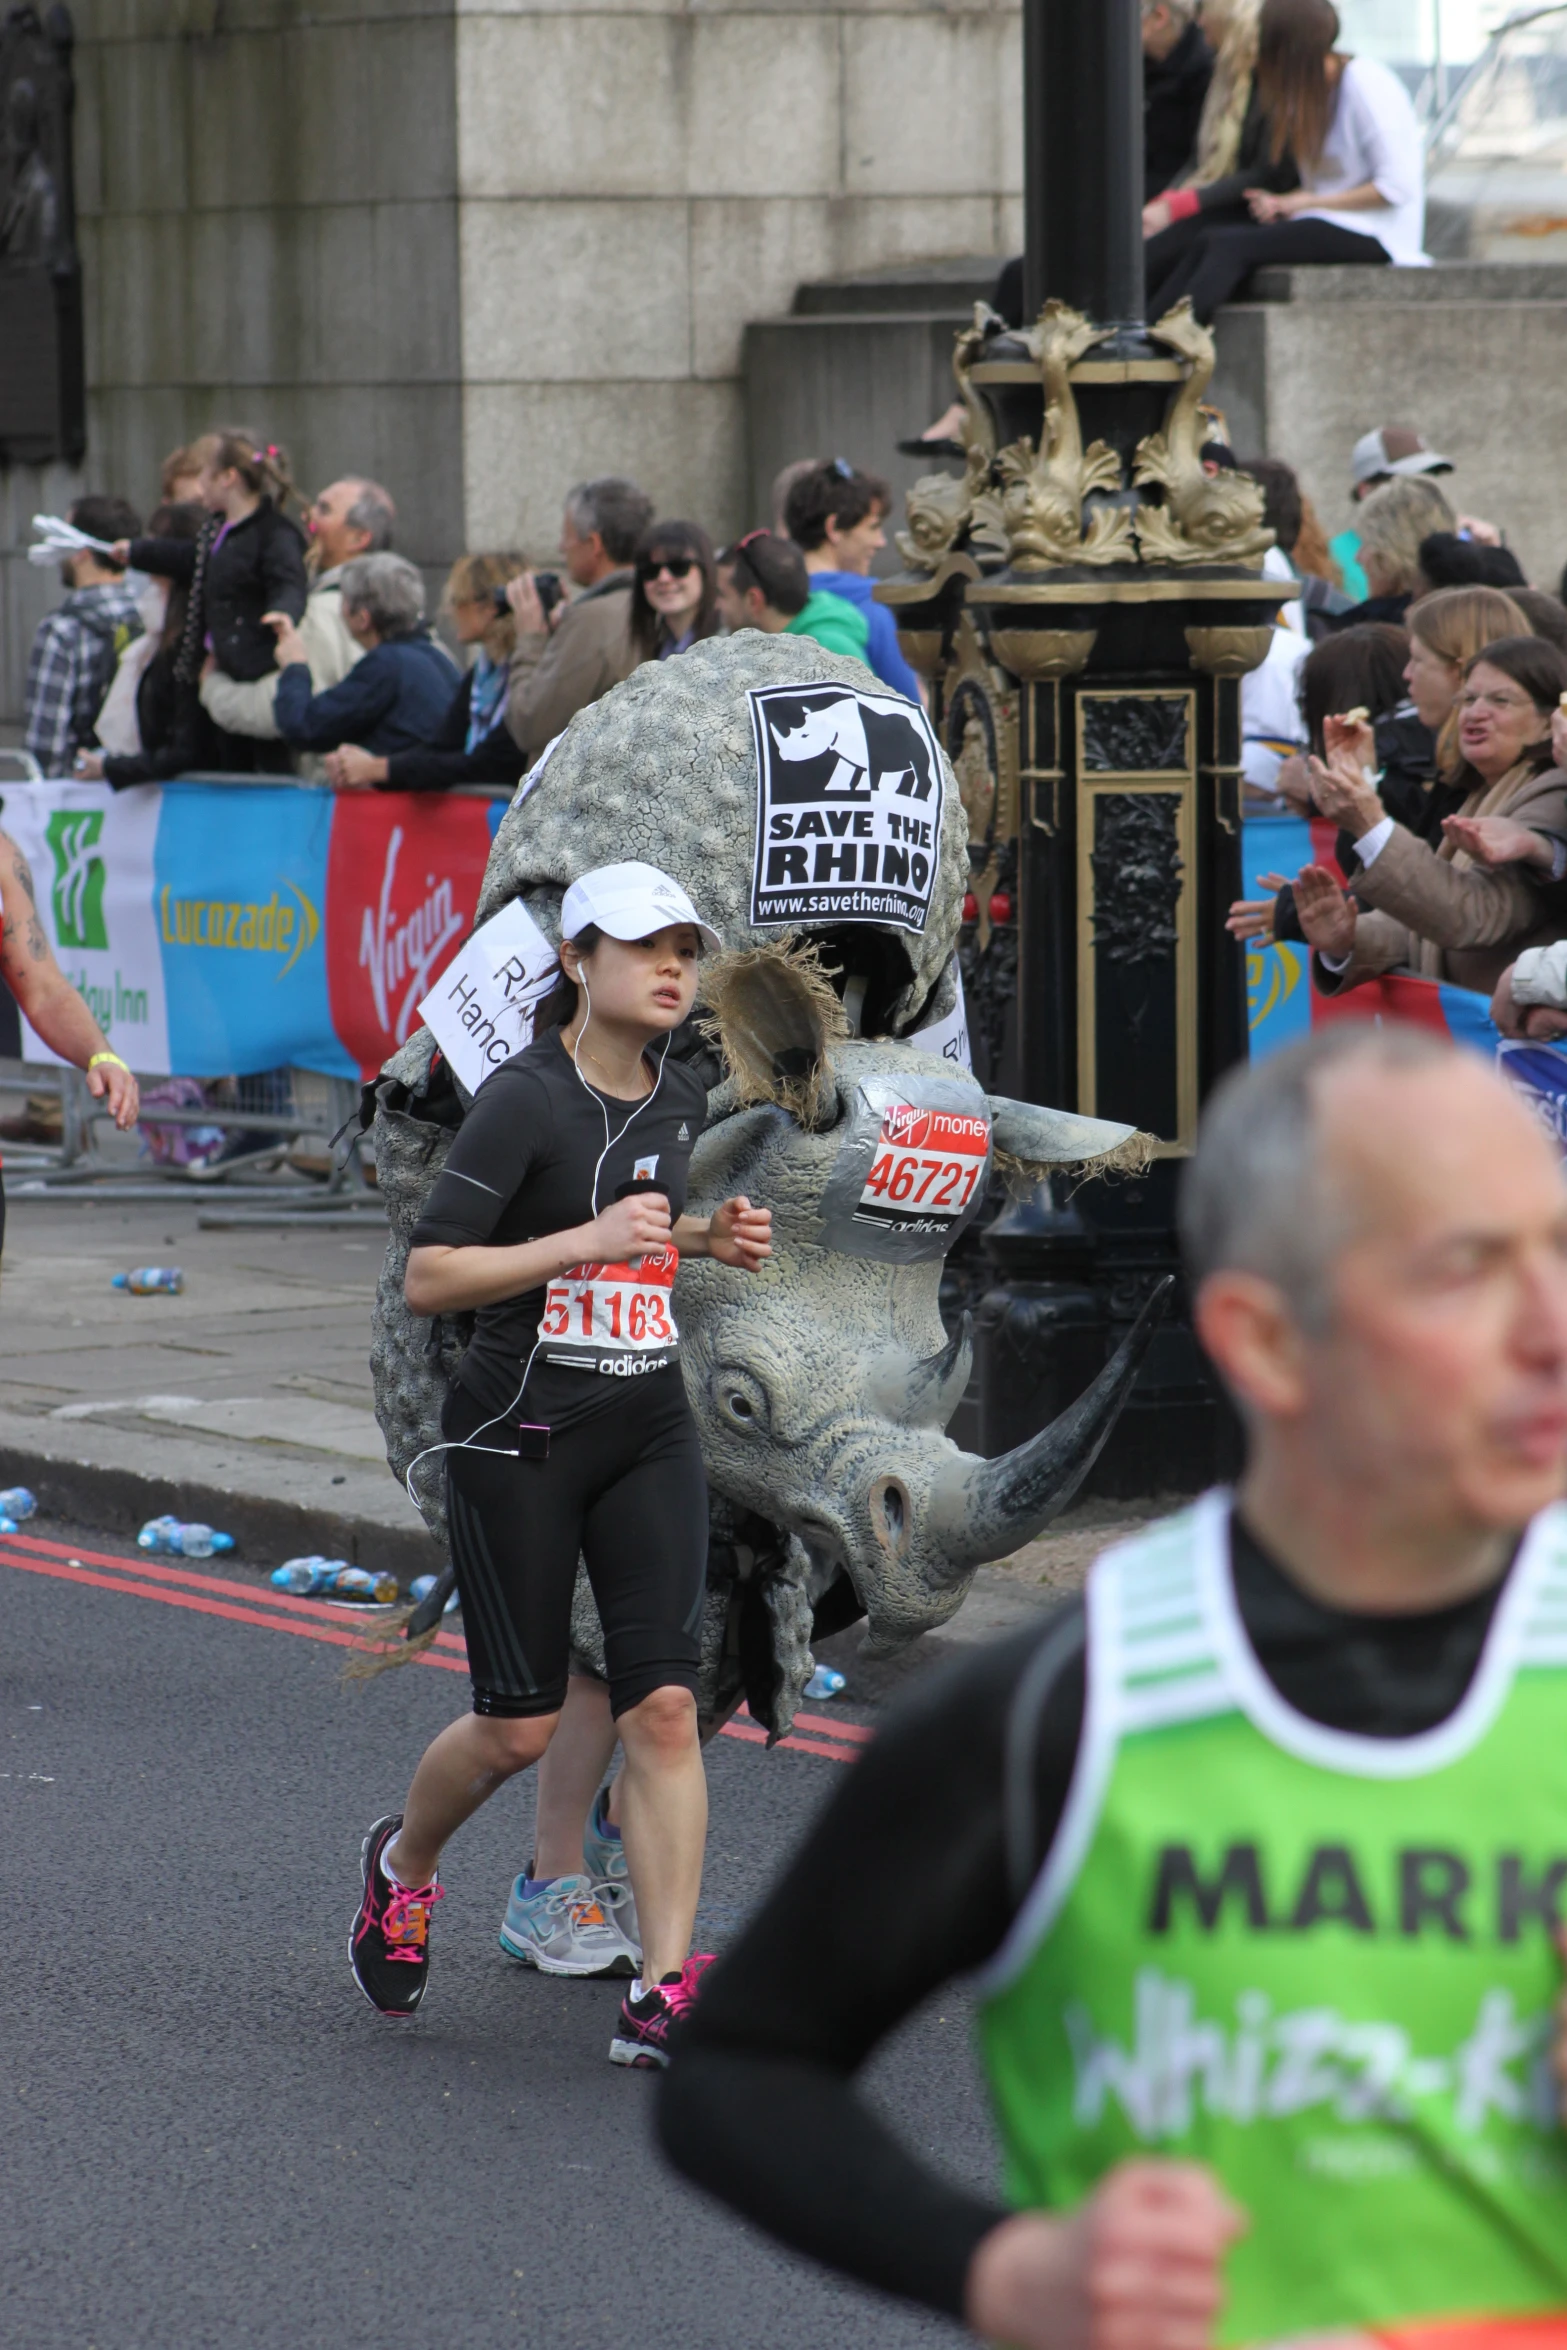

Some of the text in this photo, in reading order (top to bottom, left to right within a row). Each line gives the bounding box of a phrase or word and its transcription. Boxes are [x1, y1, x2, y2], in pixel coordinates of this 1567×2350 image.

[769, 810, 931, 849] SAVE THE
[766, 843, 929, 892] RHINO
[161, 884, 295, 953] Lucozade
[758, 891, 925, 926] www.savetherhino.org
[359, 826, 464, 1046] Virgin
[885, 1106, 989, 1144] Virgin money
[866, 1153, 980, 1207] 46721
[543, 1288, 672, 1342] 51163
[1148, 1842, 1567, 1943] MARK
